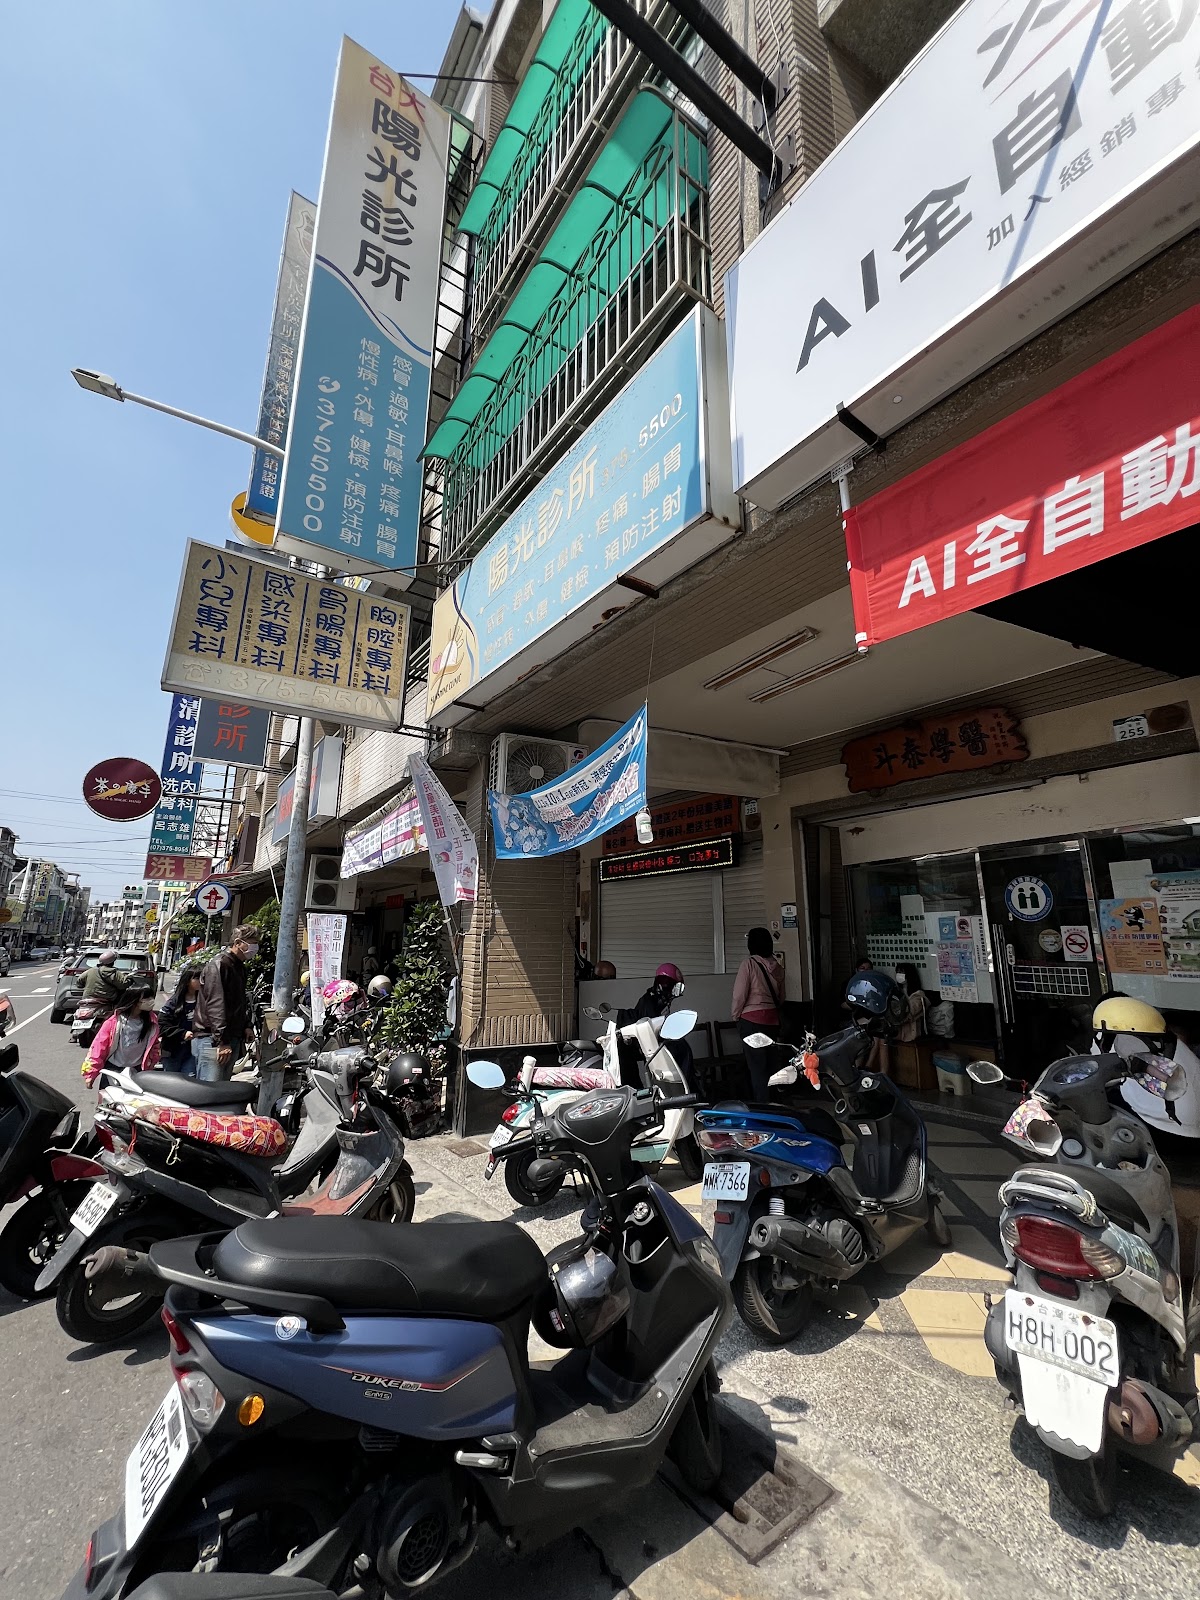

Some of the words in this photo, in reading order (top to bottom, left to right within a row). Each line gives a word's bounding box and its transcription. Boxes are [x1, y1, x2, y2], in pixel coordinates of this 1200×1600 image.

[369, 64, 426, 123] 台大
[353, 97, 422, 302] 陽光診所
[987, 60, 1200, 252] 加入經銷專
[487, 444, 600, 597] 陽光診所
[188, 554, 239, 659] 小兒專科
[251, 570, 296, 672] 感染專科
[361, 605, 398, 695] 胸腔專科
[1120, 725, 1146, 741] 255
[150, 857, 206, 880] 洗腎
[351, 1372, 402, 1389] DUKE
[1008, 1310, 1115, 1375] H8H-002
